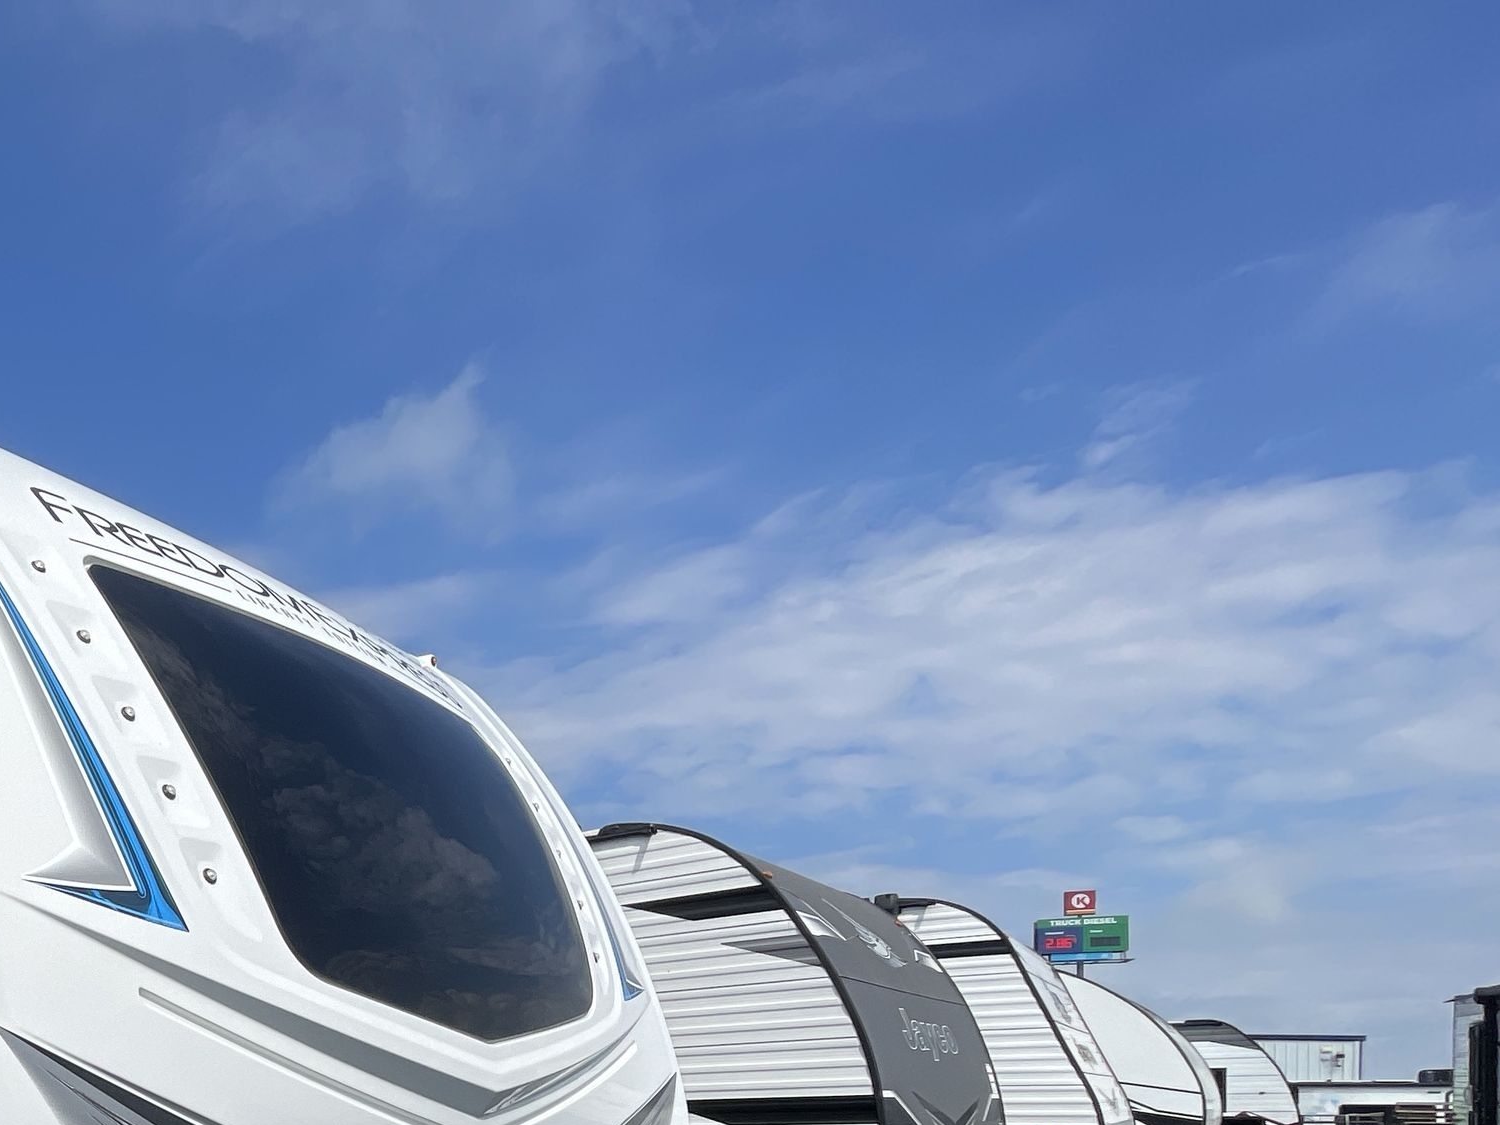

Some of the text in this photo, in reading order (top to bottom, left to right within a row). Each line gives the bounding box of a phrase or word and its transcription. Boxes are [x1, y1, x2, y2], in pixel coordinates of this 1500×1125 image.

[30, 486, 320, 623] FREEDOM
[1050, 916, 1118, 927] TRUCK DIESEL
[898, 1007, 960, 1062] Jayco
